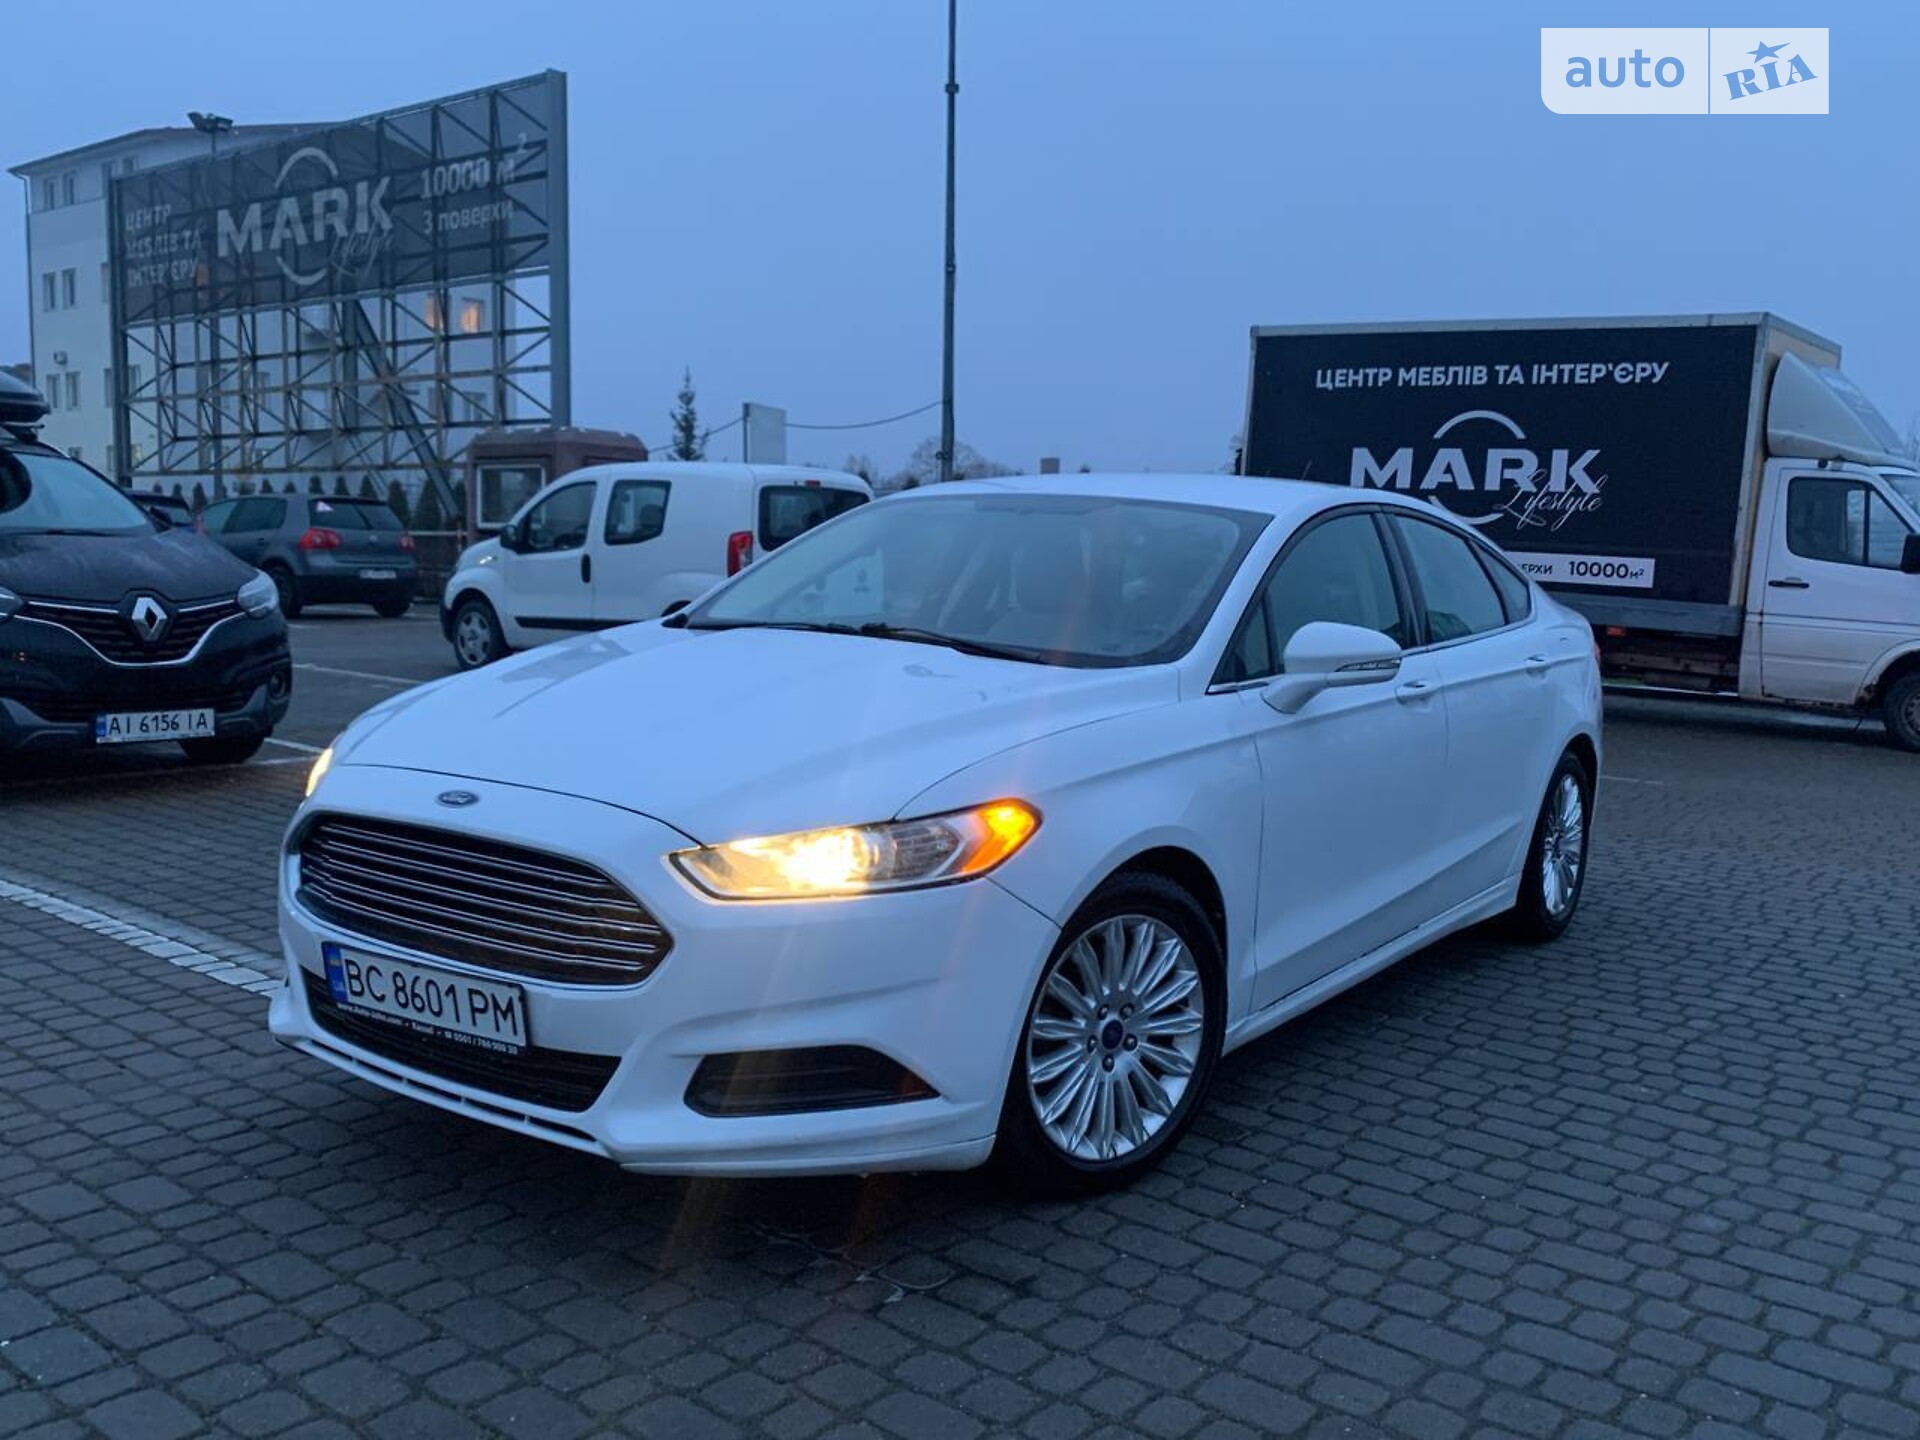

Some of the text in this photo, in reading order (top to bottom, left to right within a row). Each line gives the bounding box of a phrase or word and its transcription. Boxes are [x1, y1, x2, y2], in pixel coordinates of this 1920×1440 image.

[420, 157, 490, 199] 10000
[216, 176, 393, 257] MARK
[1315, 361, 1670, 390] ЦЕНТР МЕБЛІВ ТА ІНТЕР'ЄРУ
[1350, 447, 1601, 493] MARK
[1493, 468, 1609, 531] Lifestyle
[139, 713, 180, 733] 6156
[344, 958, 386, 1003] BC
[392, 970, 462, 1024] 8601
[467, 986, 519, 1037] PM
